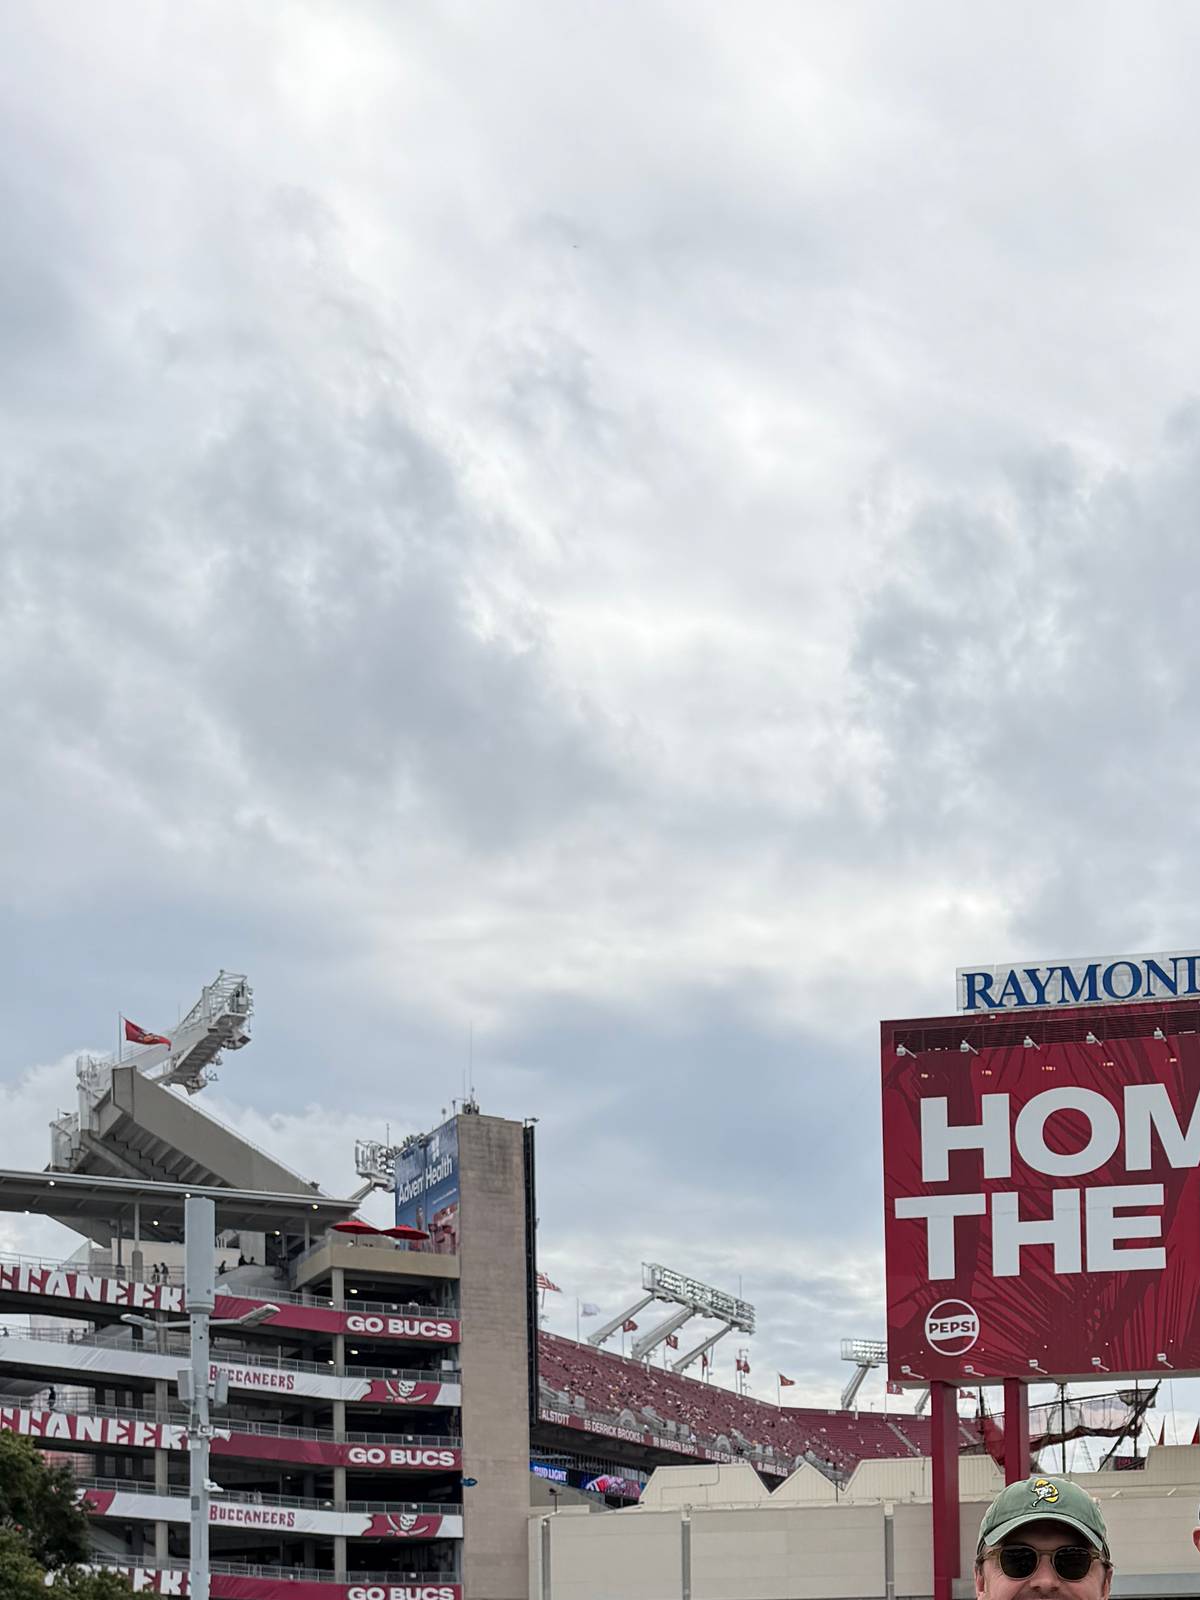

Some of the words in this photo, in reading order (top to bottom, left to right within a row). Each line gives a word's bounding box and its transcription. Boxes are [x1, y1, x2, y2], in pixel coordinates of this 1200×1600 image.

[895, 1183, 1167, 1280] THE
[346, 1315, 384, 1333] GO
[388, 1318, 453, 1338] BUCS
[929, 1321, 976, 1334] PEPSI
[210, 1364, 295, 1390] BCCANEERS
[348, 1447, 386, 1464] GO
[390, 1448, 455, 1467] BUCS
[548, 1468, 567, 1481] LIGHT
[210, 1504, 295, 1527] BUCCANEERS
